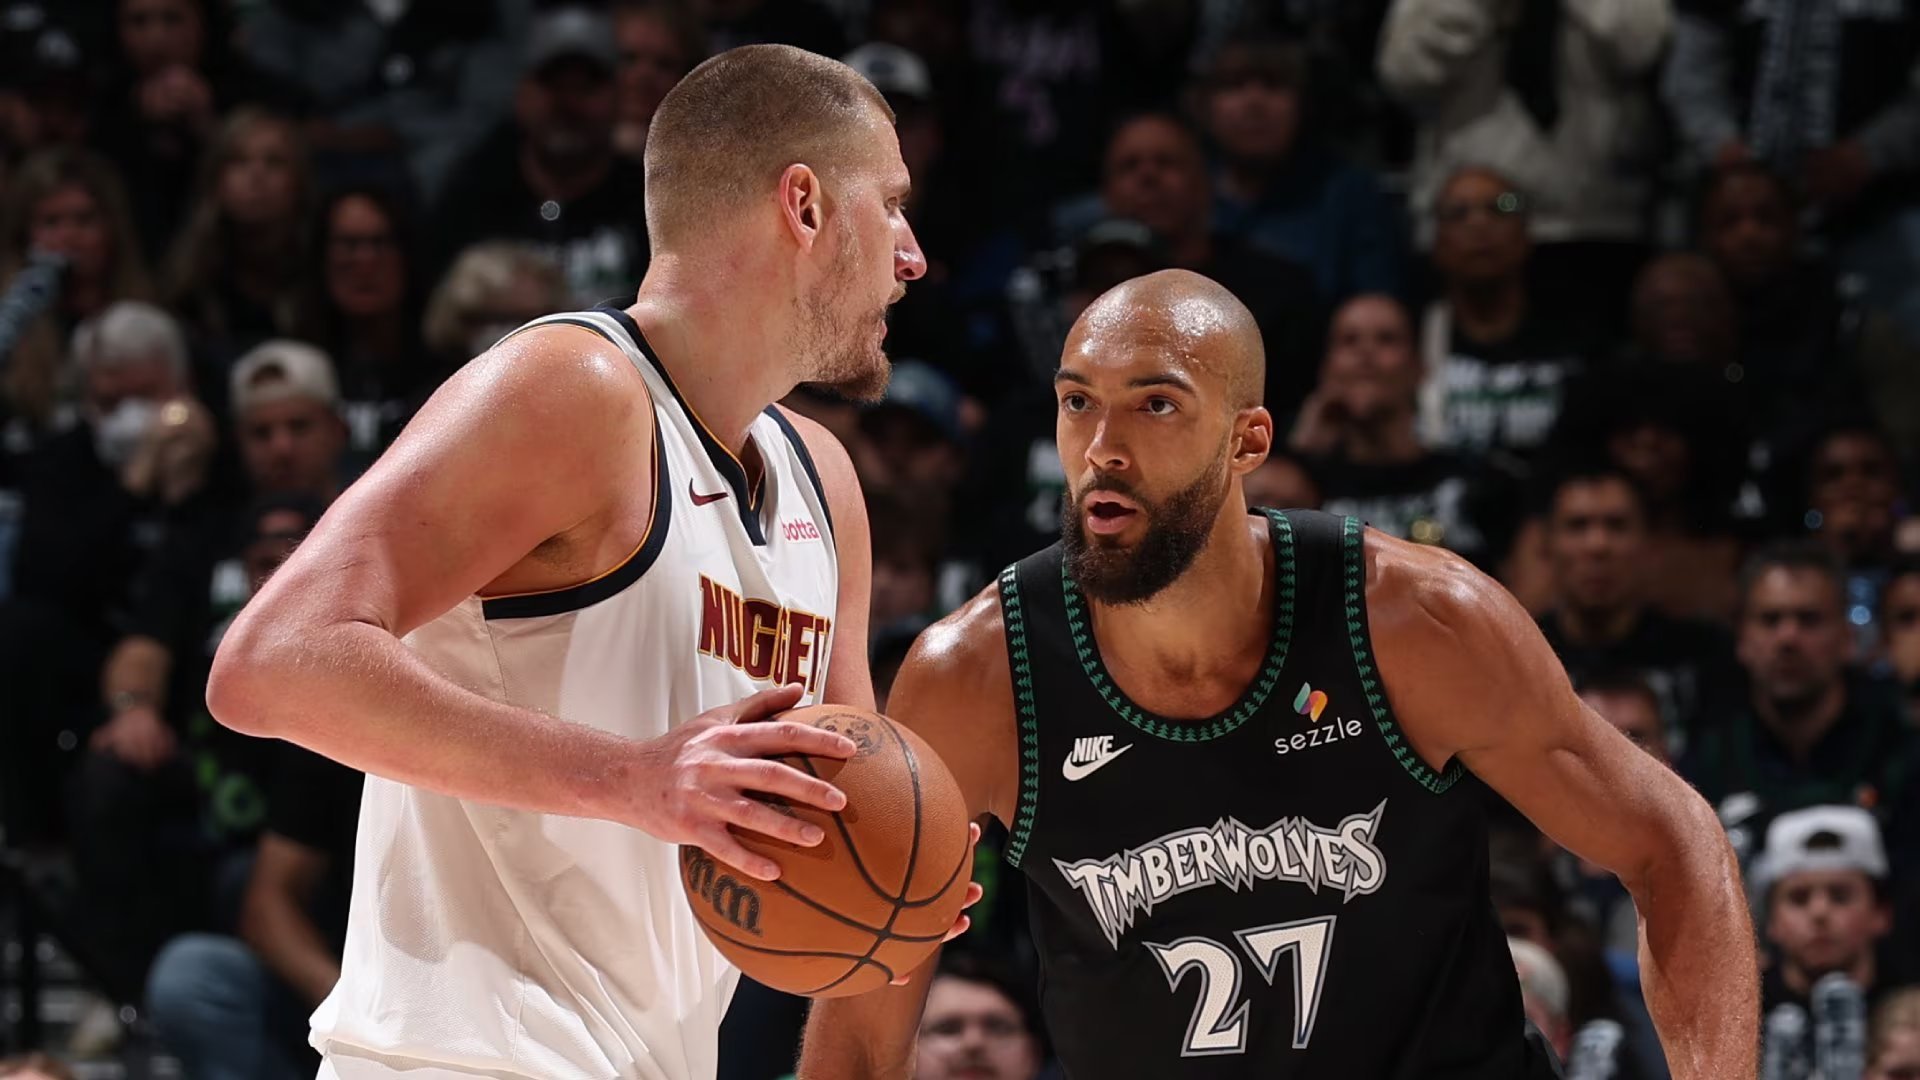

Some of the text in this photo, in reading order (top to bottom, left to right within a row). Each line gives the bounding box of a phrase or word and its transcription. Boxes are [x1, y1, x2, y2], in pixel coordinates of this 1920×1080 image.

[697, 571, 832, 695] NUGGET
[1072, 735, 1115, 763] NIKE
[1274, 716, 1363, 755] sezzle
[1052, 797, 1389, 951] TIMBERWOLVES
[1141, 914, 1338, 1058] 27
